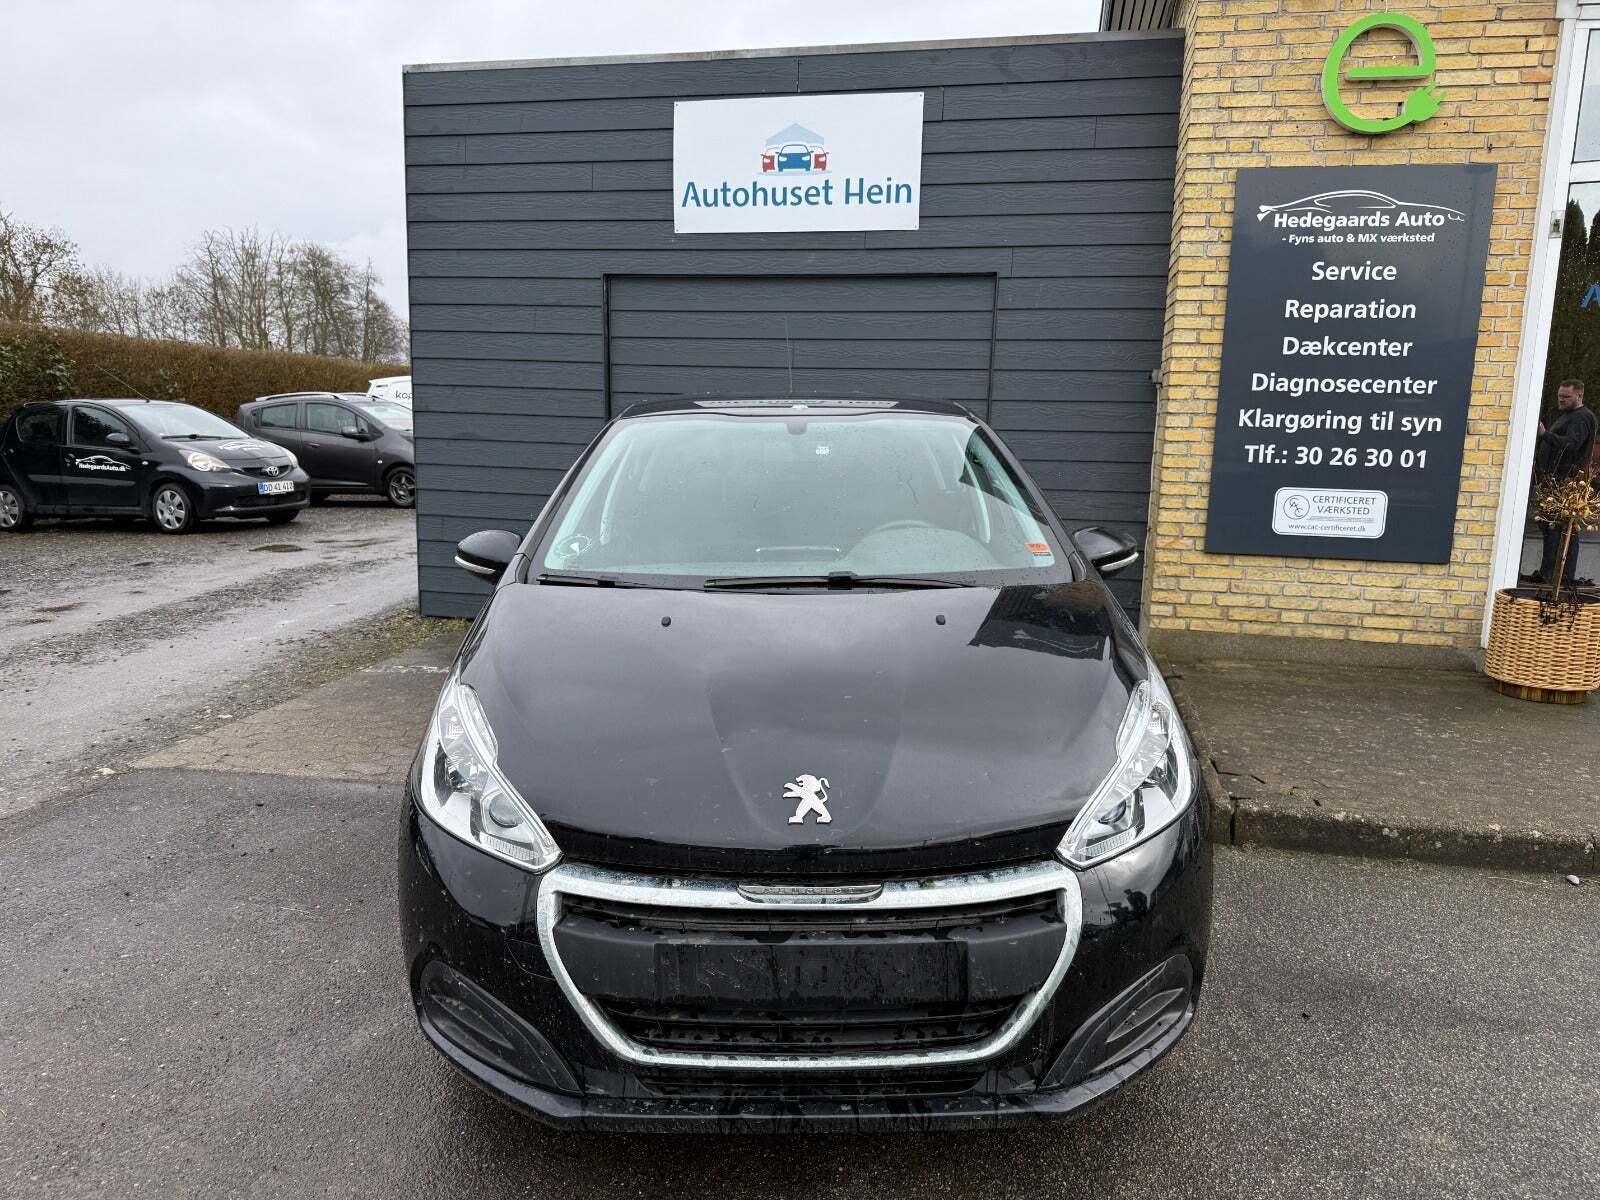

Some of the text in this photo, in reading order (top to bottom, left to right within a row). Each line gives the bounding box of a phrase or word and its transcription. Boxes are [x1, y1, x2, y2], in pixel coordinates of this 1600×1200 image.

[681, 177, 912, 208] Autohuset Hein
[1274, 211, 1445, 232] Hedegaards Auto
[1288, 234, 1315, 246] Fyns
[1317, 234, 1344, 244] auto
[1346, 233, 1356, 243] &
[1358, 233, 1378, 243] MX
[1380, 232, 1436, 243] værksted
[1311, 260, 1398, 281] Service
[1284, 298, 1417, 324] Reparation
[1282, 335, 1414, 357] Dækcenter
[1251, 372, 1438, 397] Diagnosecenter
[1238, 407, 1442, 437] Klargøring til syn
[1244, 443, 1427, 469] Tlf.: 30 26 30 01
[1312, 495, 1377, 505] CERTIFICERET
[1317, 505, 1370, 515] VÆRKSTED
